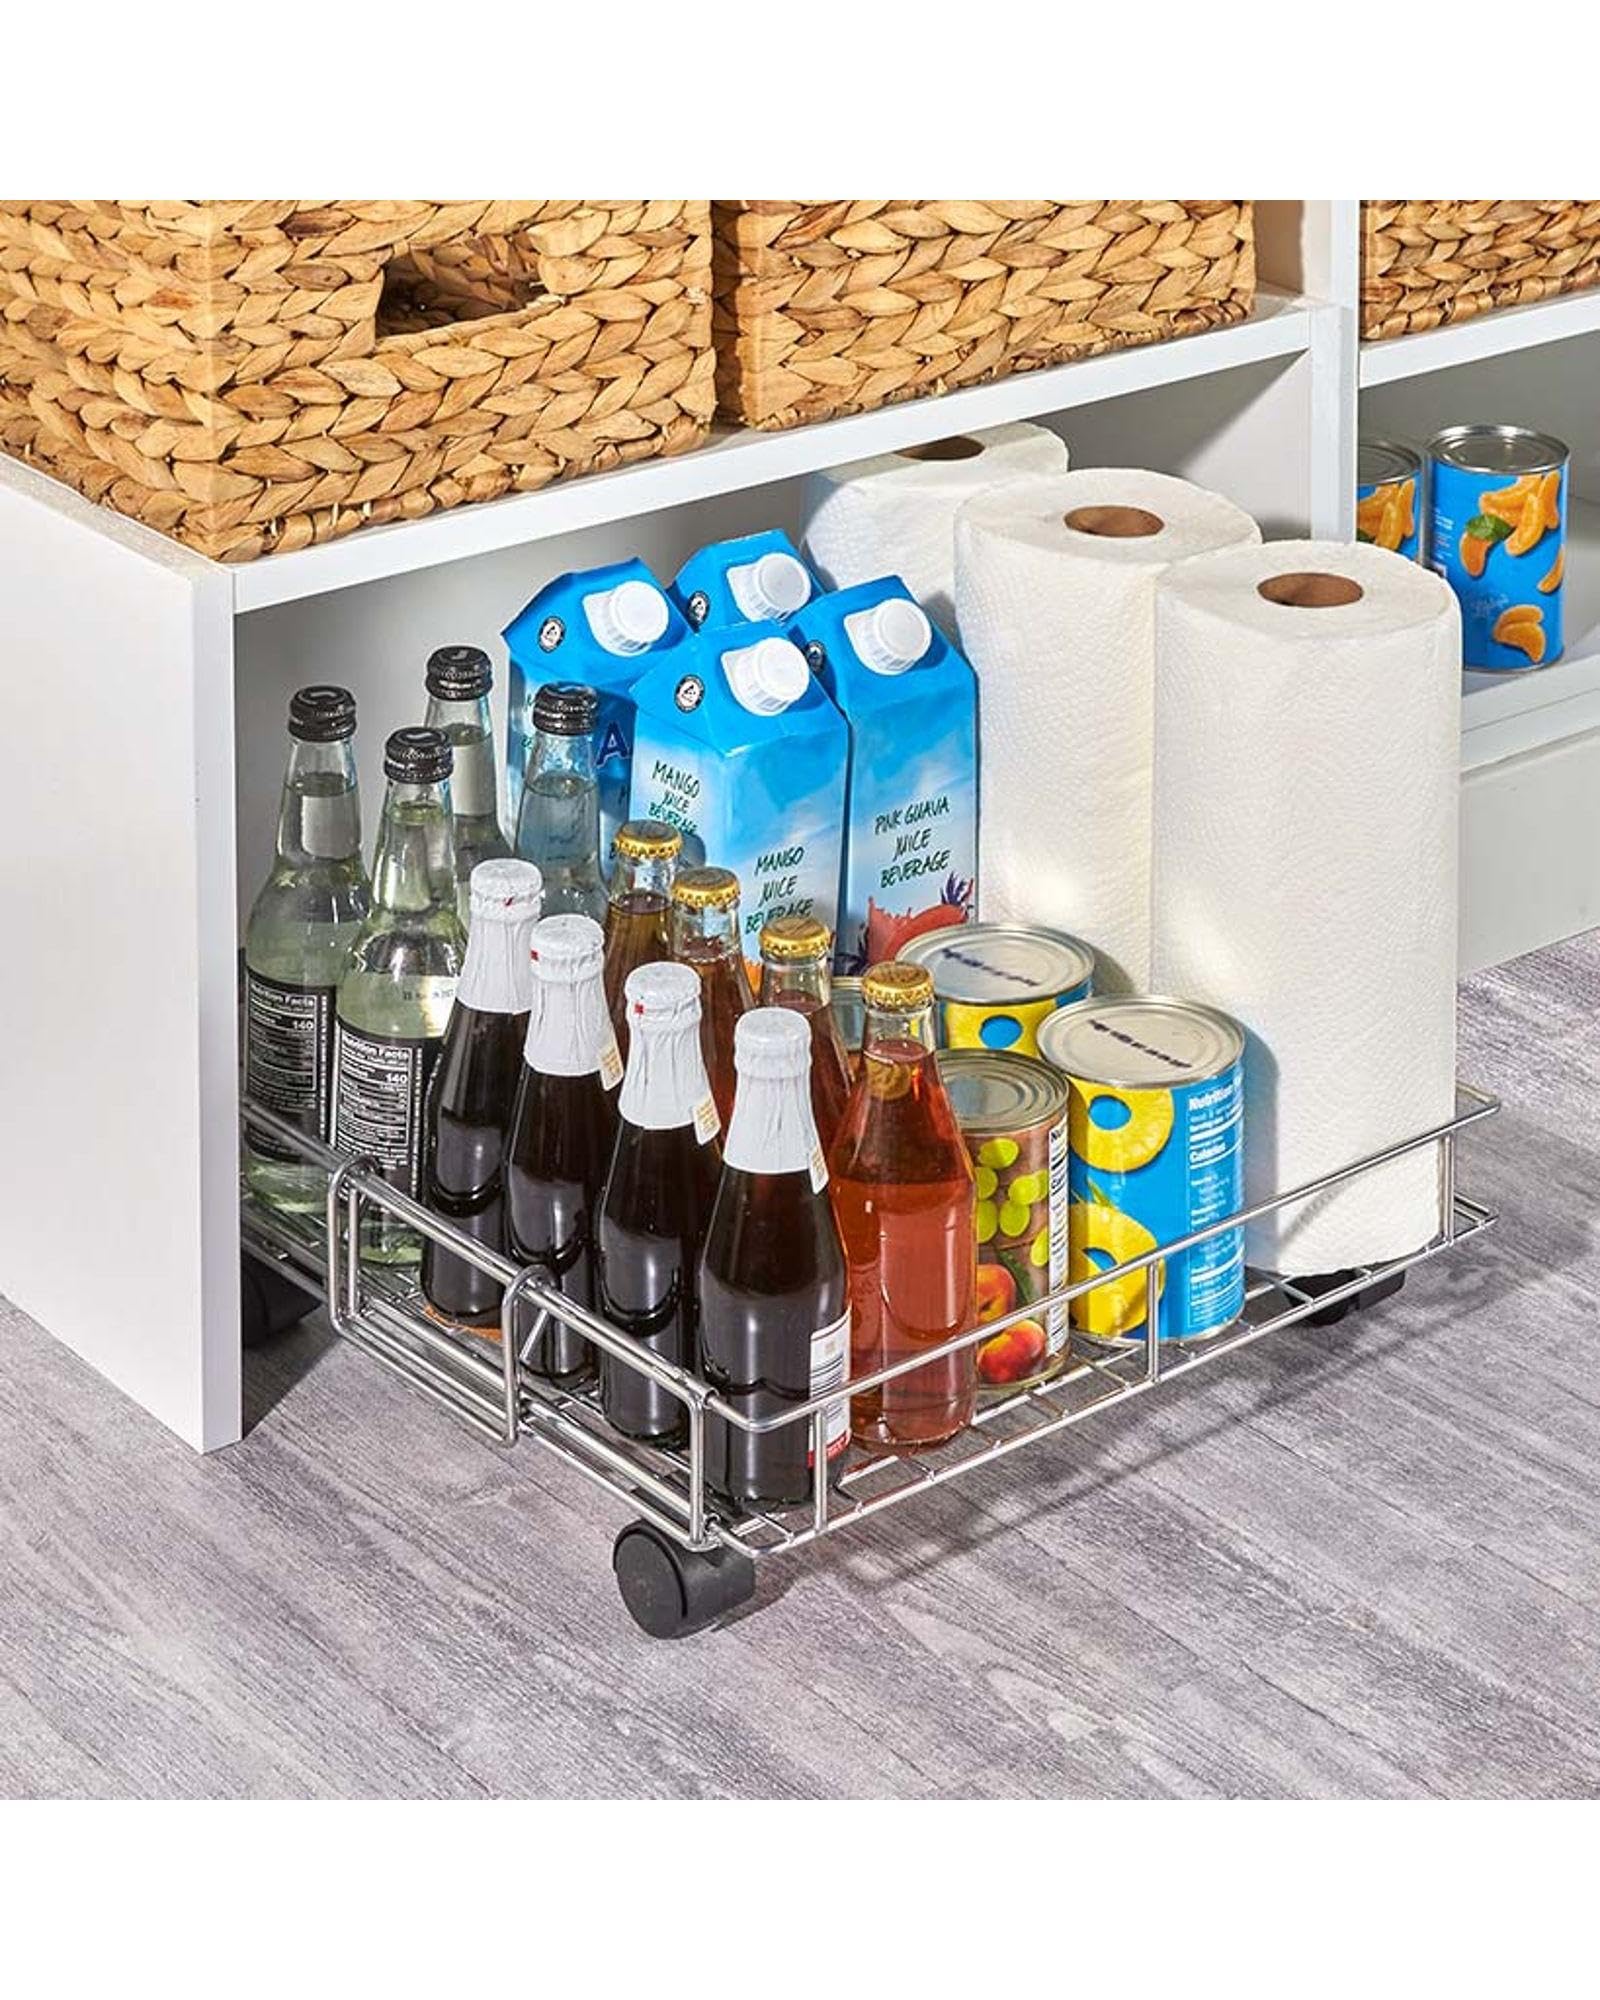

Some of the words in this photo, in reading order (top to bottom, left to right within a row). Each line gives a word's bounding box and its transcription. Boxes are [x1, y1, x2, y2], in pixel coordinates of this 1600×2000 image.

[652, 759, 701, 799] MANGO
[648, 802, 699, 835] BEVERAGE
[661, 790, 691, 814] JUICE
[875, 809, 903, 835] PINK
[904, 796, 950, 825] GUAVA
[754, 846, 805, 876] MANGO
[892, 828, 931, 862] JUICE
[881, 850, 952, 889] BEVERAGE
[758, 875, 798, 907] JUICE
[385, 1072, 408, 1084] 140
